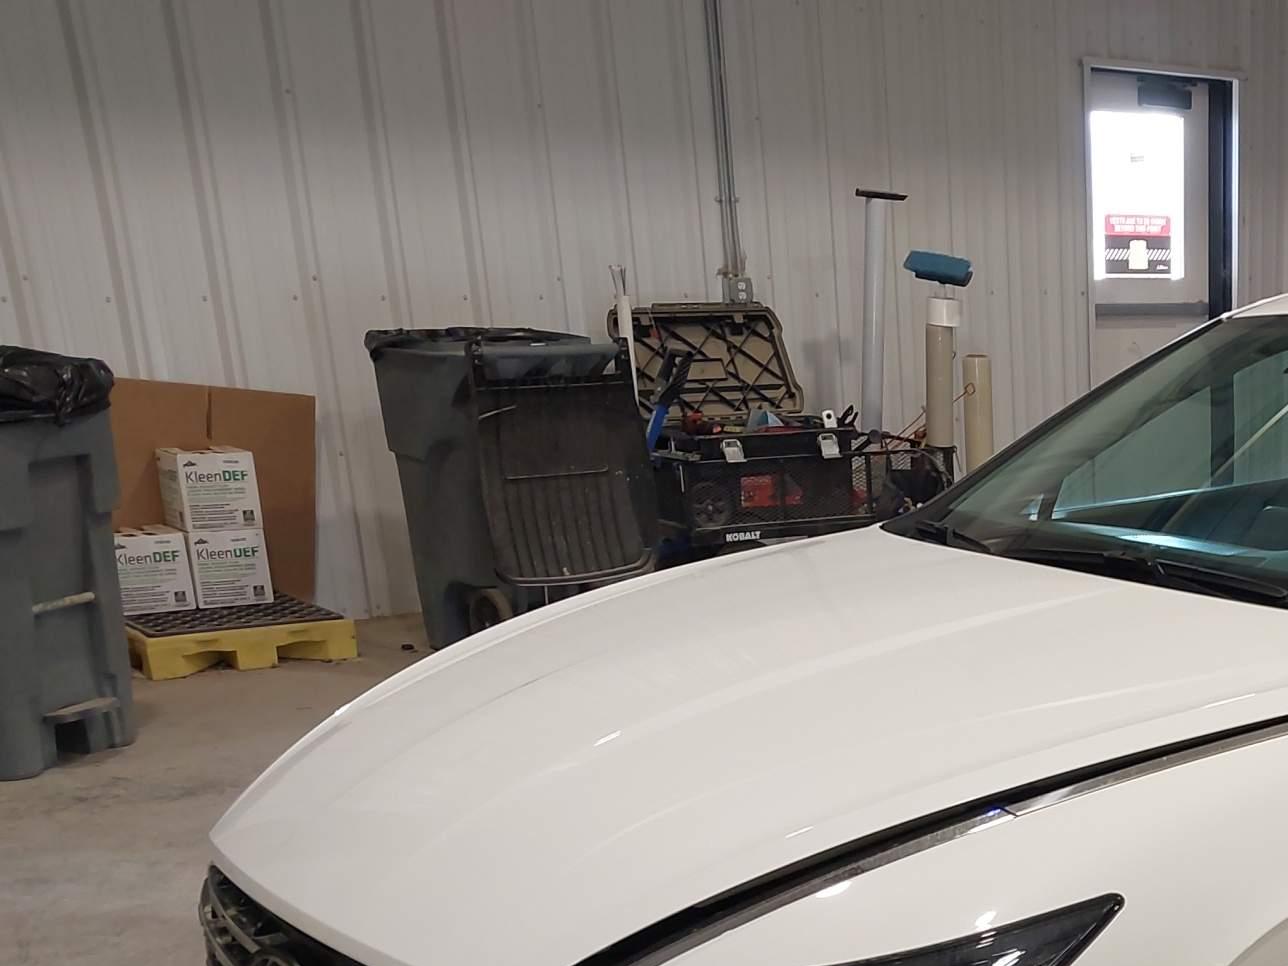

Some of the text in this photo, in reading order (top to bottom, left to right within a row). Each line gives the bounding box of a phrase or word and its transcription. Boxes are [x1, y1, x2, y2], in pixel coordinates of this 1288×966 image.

[184, 470, 249, 484] KleenDEF
[725, 530, 761, 542] KOBALT
[195, 546, 260, 561] KleenDEF
